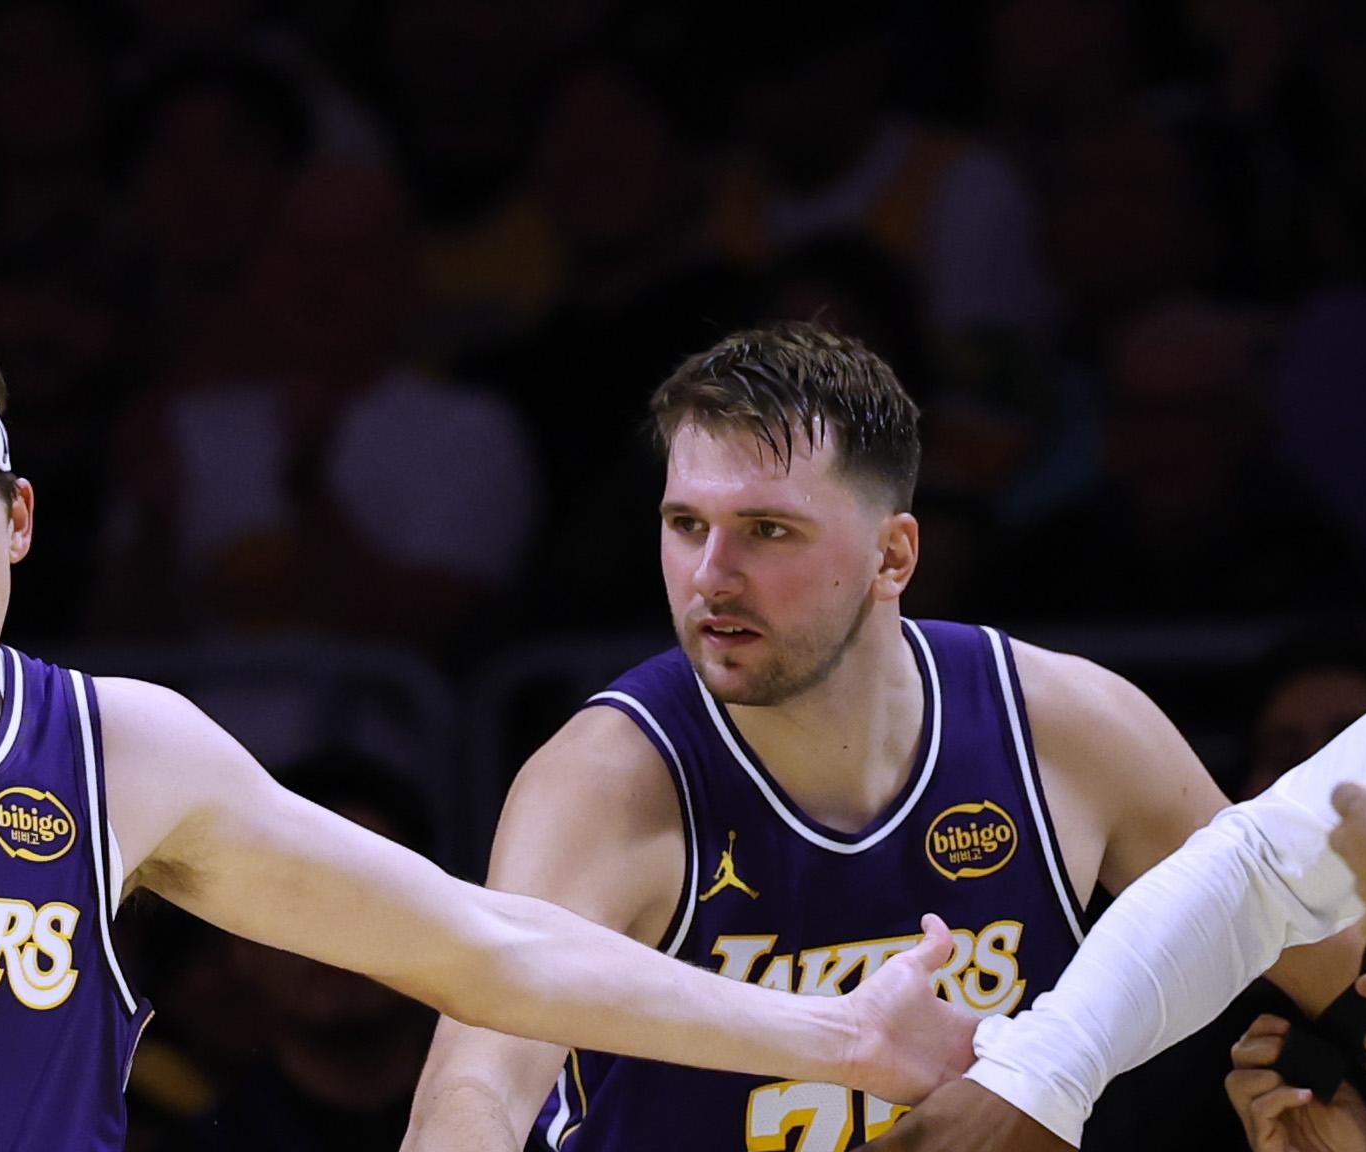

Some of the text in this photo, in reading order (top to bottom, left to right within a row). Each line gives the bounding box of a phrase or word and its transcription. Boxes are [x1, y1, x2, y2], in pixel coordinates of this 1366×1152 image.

[11, 830, 40, 845] 비비고
[934, 822, 1012, 853] bibigo
[711, 919, 1027, 1018] KRS
